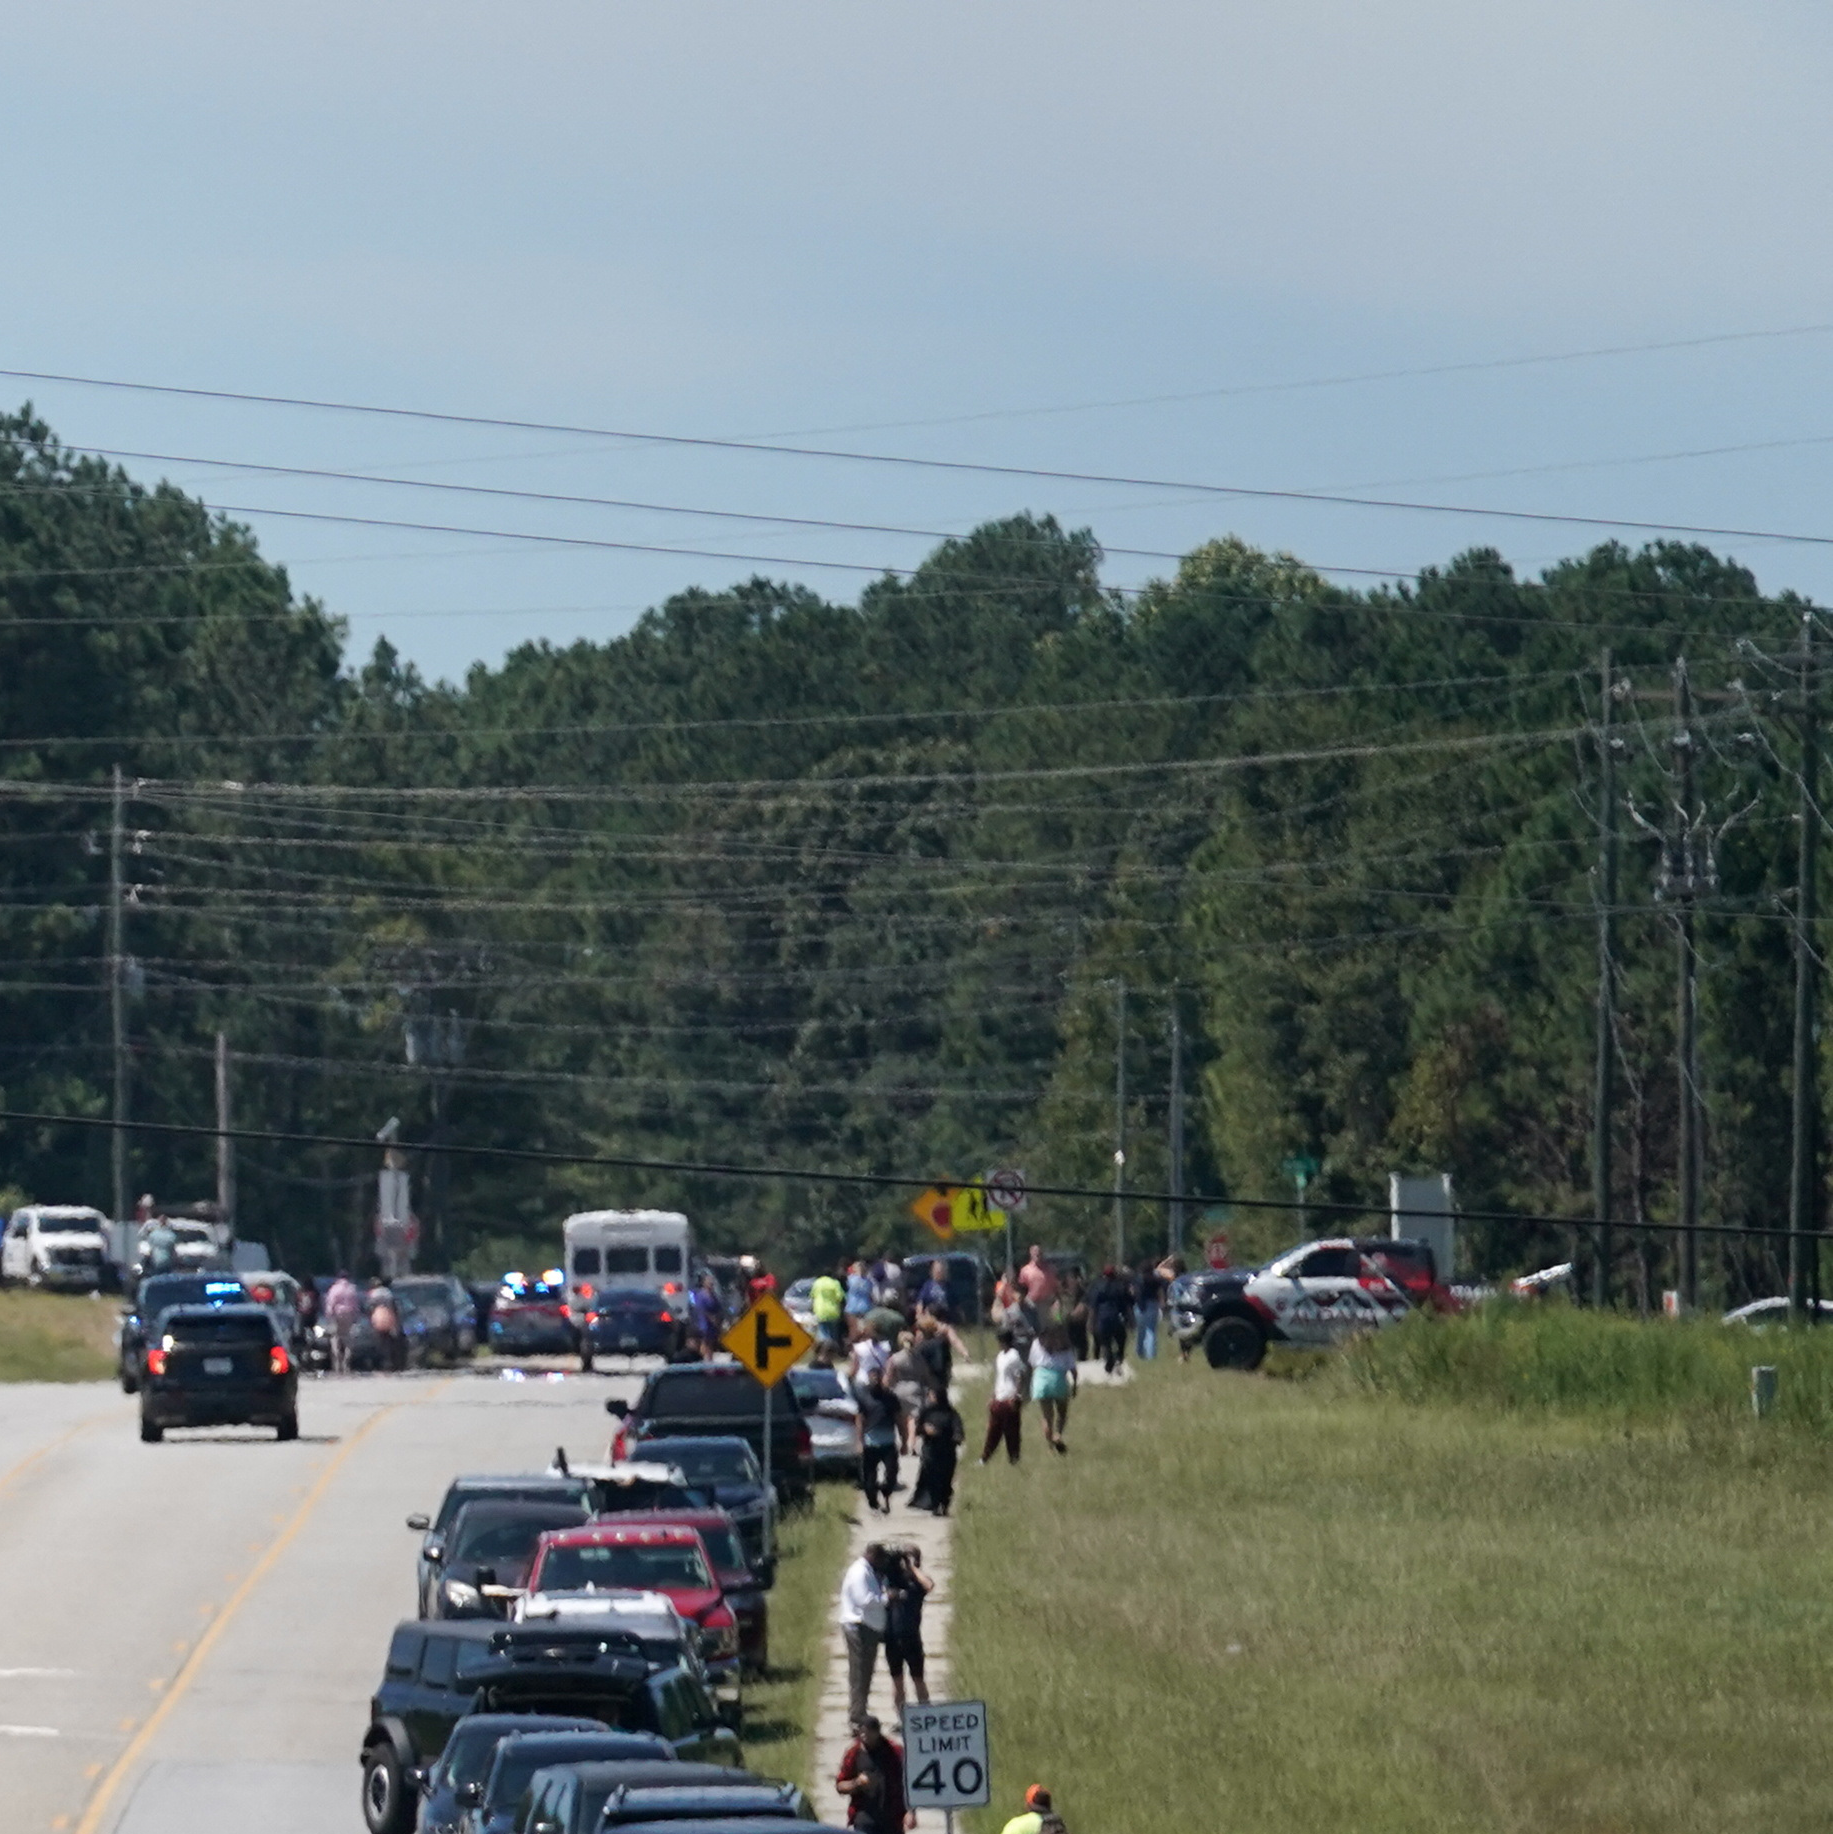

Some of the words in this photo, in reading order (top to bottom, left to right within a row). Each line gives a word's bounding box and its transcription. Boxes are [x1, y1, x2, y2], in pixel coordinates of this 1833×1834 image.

[910, 1713, 979, 1732] SPEED
[918, 1734, 971, 1753] LIMIT
[911, 1756, 983, 1795] 40
